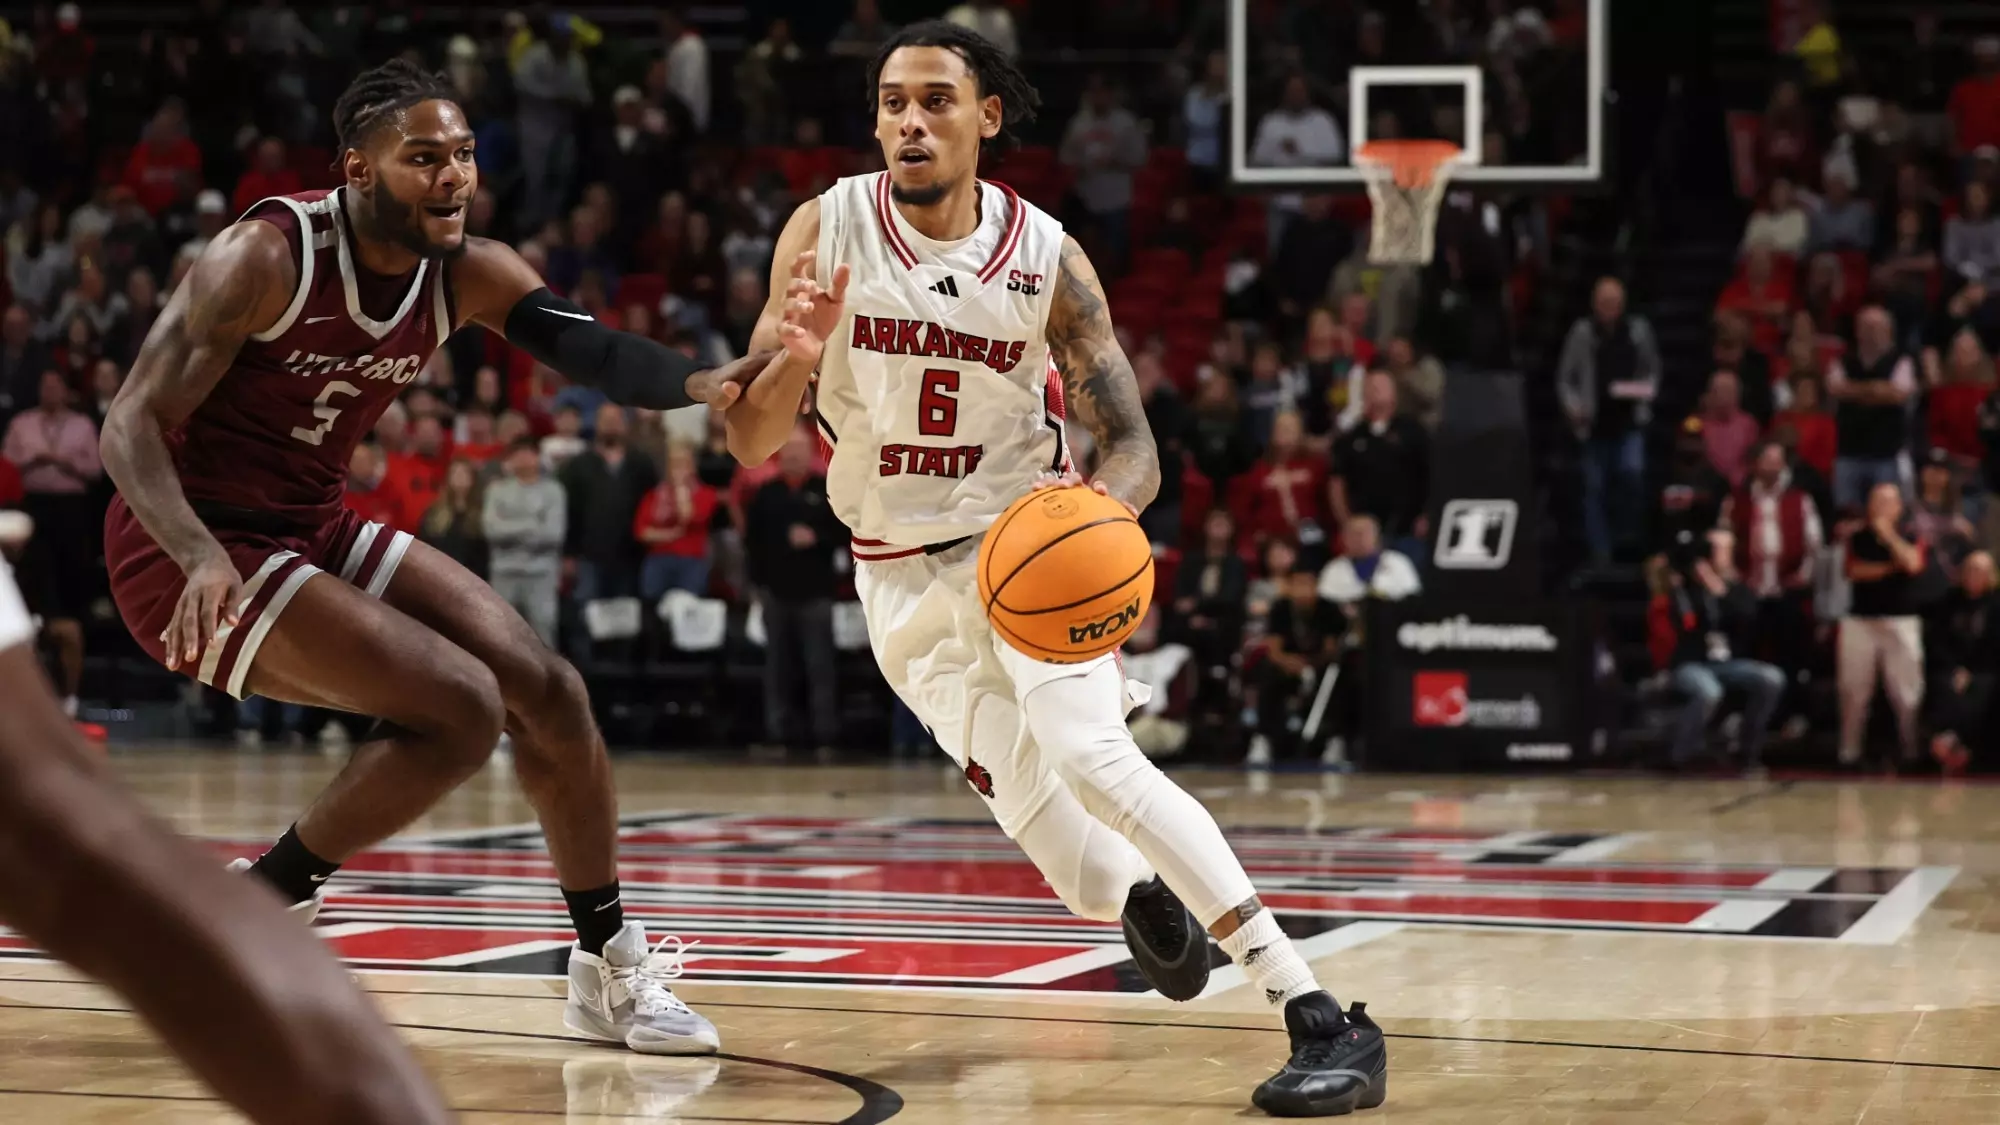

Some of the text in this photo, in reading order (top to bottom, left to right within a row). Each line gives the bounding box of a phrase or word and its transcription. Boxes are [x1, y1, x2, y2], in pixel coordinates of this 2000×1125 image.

[1006, 269, 1043, 296] SBC
[851, 314, 1027, 374] ARKANSAS
[360, 354, 421, 385] ROC
[290, 380, 363, 446] 5
[918, 368, 960, 437] 6
[879, 443, 984, 480] STATE
[1068, 596, 1141, 645] NCAA
